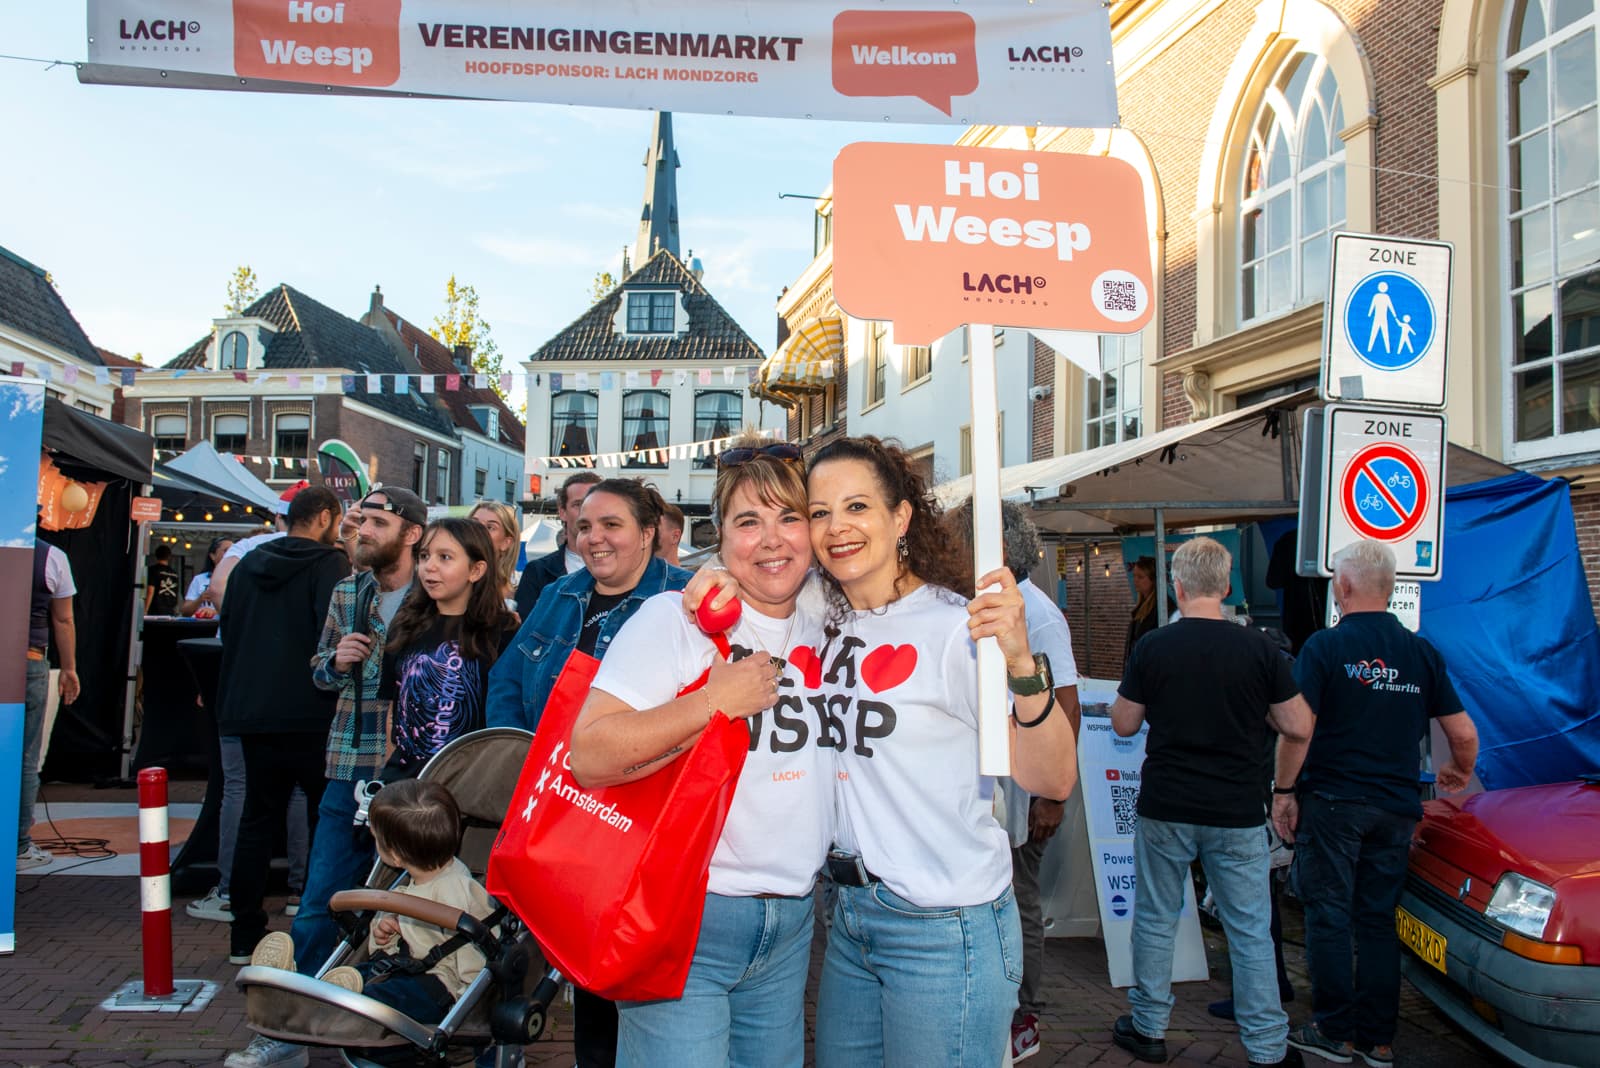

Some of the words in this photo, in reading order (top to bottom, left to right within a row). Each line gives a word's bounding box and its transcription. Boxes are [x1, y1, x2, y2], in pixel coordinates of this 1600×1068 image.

[288, 0, 345, 24] Hoi
[120, 19, 186, 40] LACH
[418, 23, 803, 62] VERENIGINGENMARKT
[260, 40, 373, 74] Weesp
[851, 45, 957, 65] Welkom
[1008, 46, 1071, 63] LACH
[464, 60, 609, 78] HOOFDSPONSOR:
[614, 66, 658, 80] LACH
[663, 68, 758, 83] MONDZORG
[944, 160, 1040, 201] Hoi
[894, 204, 1091, 261] Weesp
[1369, 247, 1417, 265] ZONE
[963, 272, 1032, 295] LACH
[1364, 420, 1413, 437] ZONE
[1344, 663, 1399, 683] Weesp
[772, 769, 801, 783] LACH
[1120, 769, 1141, 781] YouTu
[548, 774, 633, 833] Amsterdam
